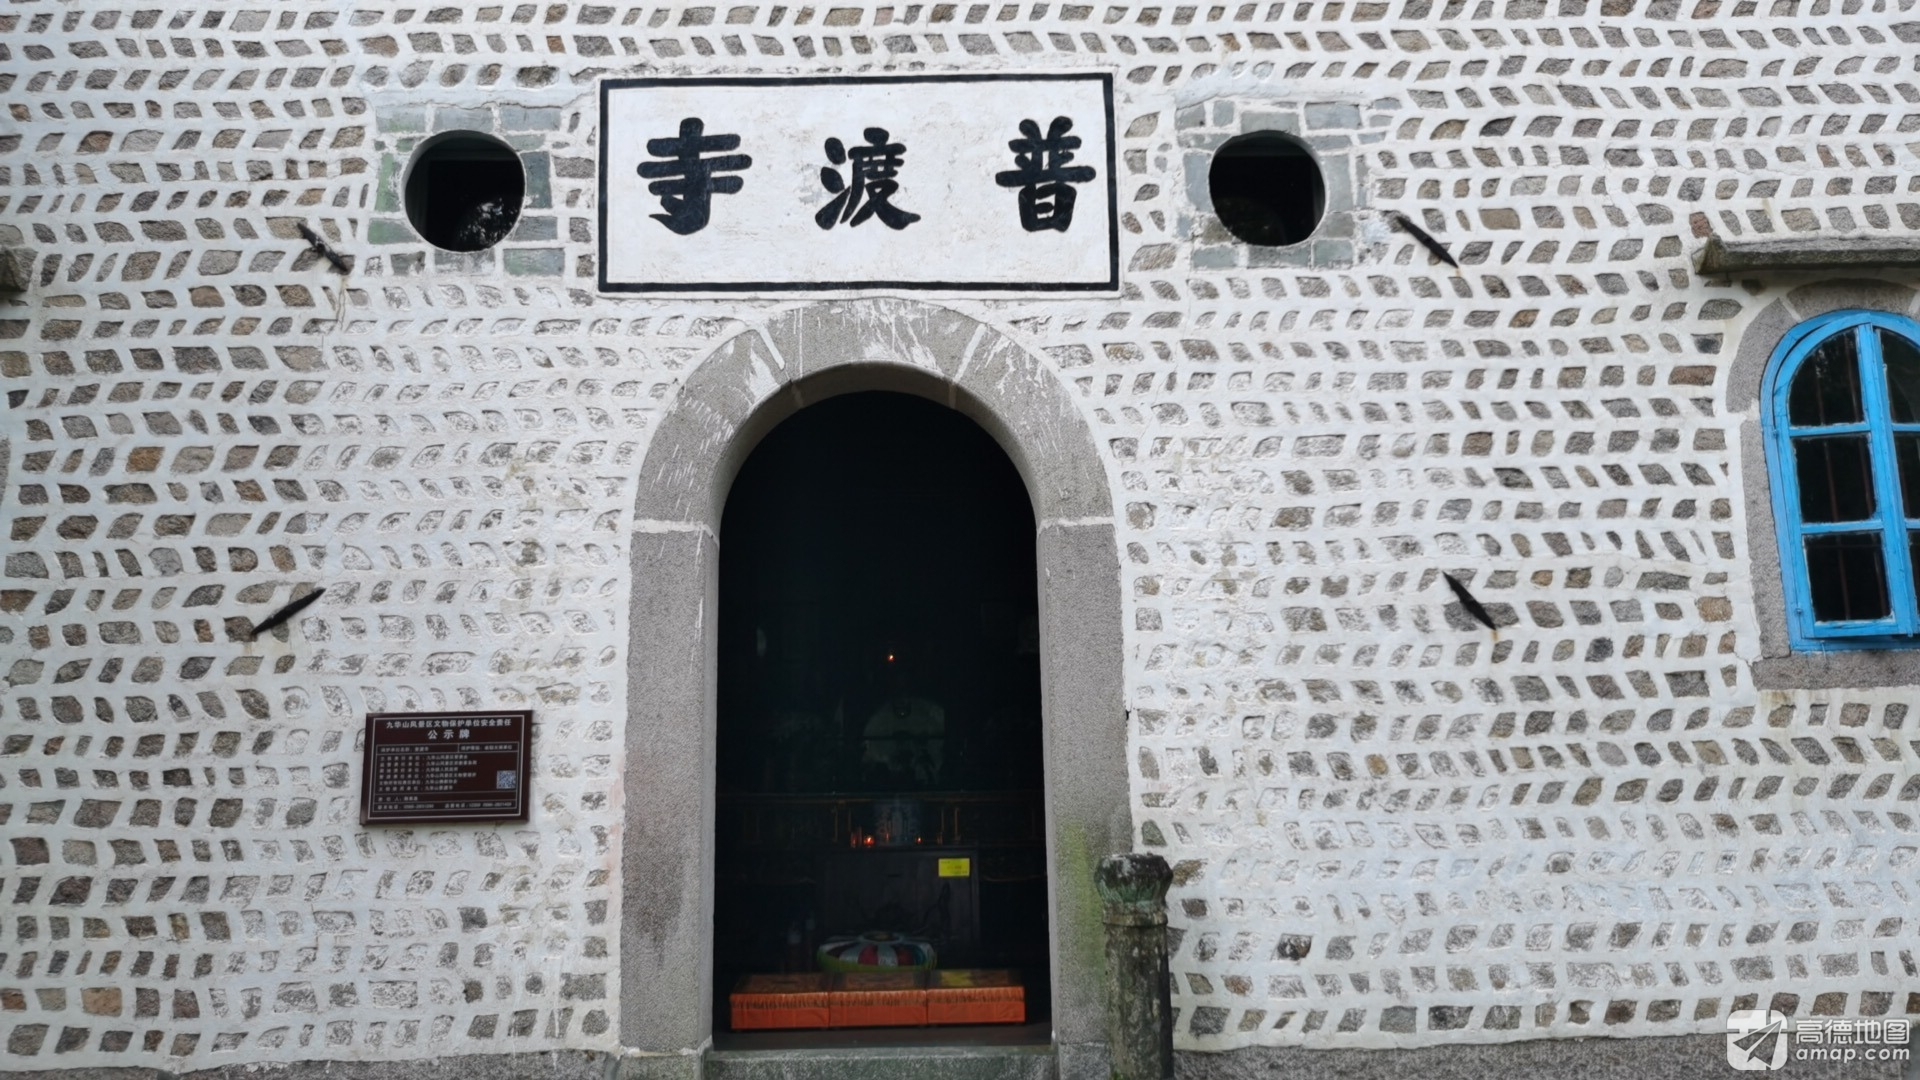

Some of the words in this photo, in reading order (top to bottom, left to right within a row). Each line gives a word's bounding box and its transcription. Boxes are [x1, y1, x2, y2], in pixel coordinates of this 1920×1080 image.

[637, 116, 1096, 235] 普渡寺
[386, 718, 512, 729] 九华山风景区文物保护单位安全责任
[427, 729, 470, 740] 公示牌
